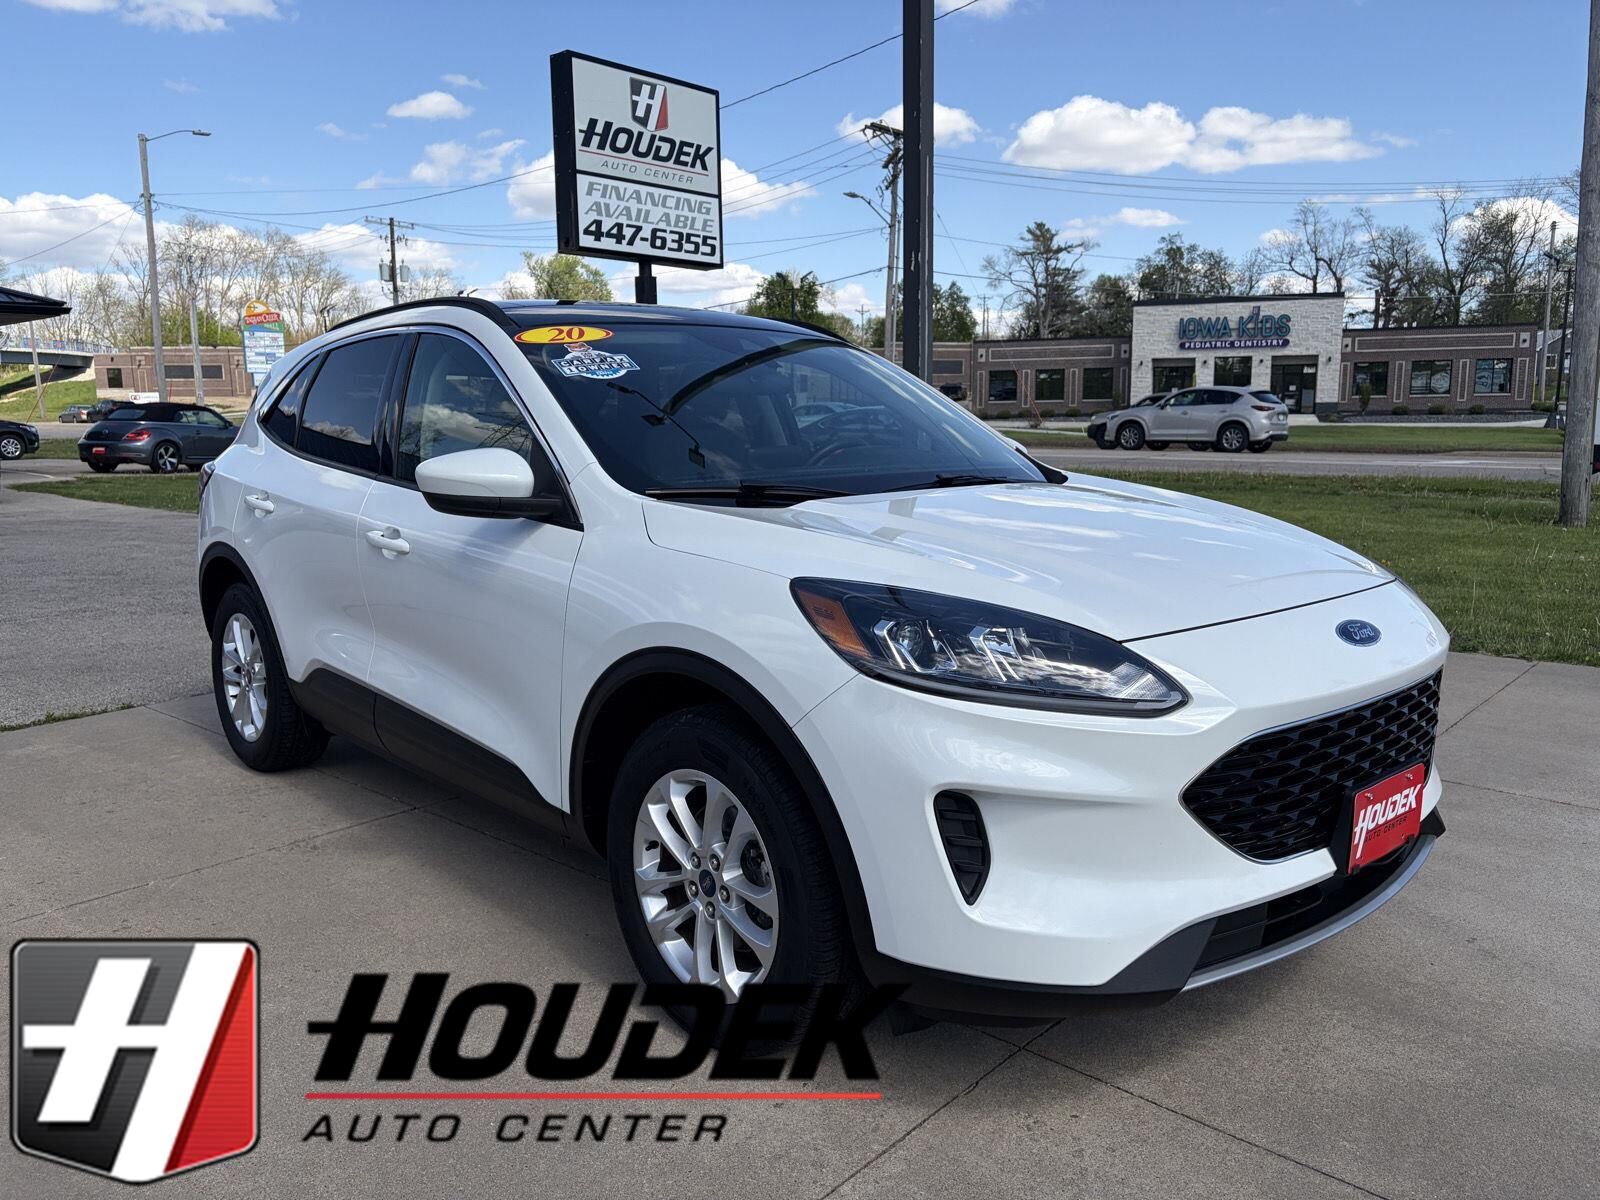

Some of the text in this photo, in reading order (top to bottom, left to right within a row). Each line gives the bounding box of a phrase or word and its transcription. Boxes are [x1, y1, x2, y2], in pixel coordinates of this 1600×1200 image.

[578, 117, 715, 171] HOUDEK
[601, 160, 694, 184] AUTO CENTER
[585, 181, 713, 216] FINANCING
[584, 200, 715, 233] AVAILABLE
[583, 219, 717, 257] 447-6355
[548, 327, 585, 341] 20
[1179, 309, 1292, 340] IOWA KIDS
[1185, 339, 1284, 349] PEDIATRIC DENTISTRY
[559, 355, 628, 368] CARFAX
[578, 362, 633, 372] OWNER
[1347, 623, 1375, 640] Ford
[1354, 783, 1422, 860] HOUDEK
